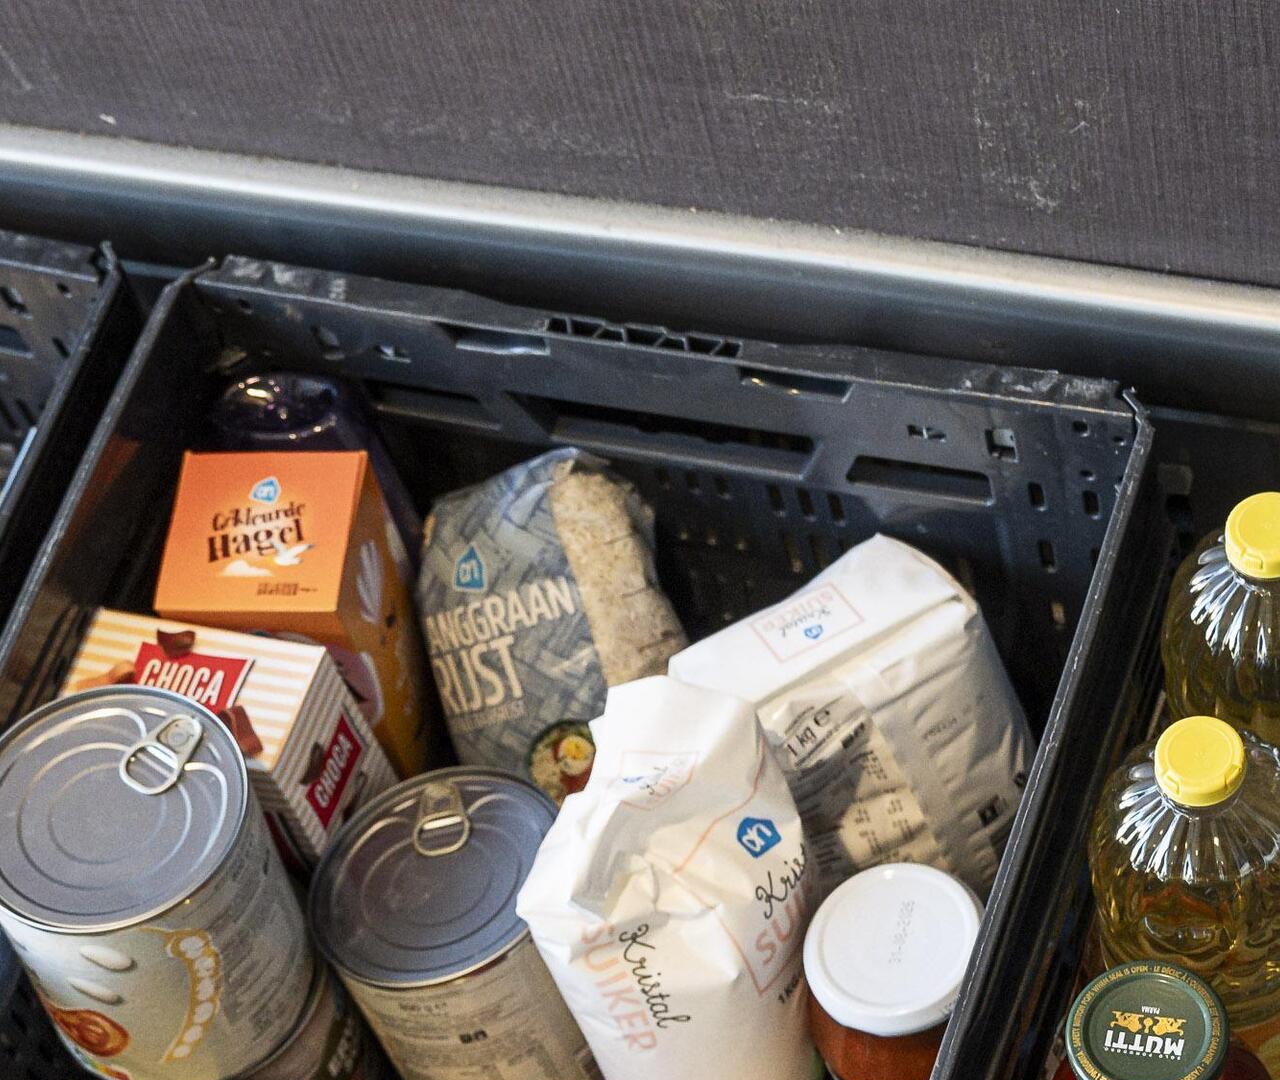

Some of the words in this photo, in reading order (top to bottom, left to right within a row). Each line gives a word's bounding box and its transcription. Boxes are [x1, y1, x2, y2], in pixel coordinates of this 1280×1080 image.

[208, 518, 304, 563] Hagel
[426, 576, 575, 655] ANGGRAAN
[139, 659, 226, 707] CHOCA
[314, 732, 353, 809] CHOCA
[755, 843, 807, 919] Kris
[582, 922, 657, 1051] SUIKER
[620, 924, 691, 1028] Kristal
[1104, 1029, 1185, 1056] MUTTI
